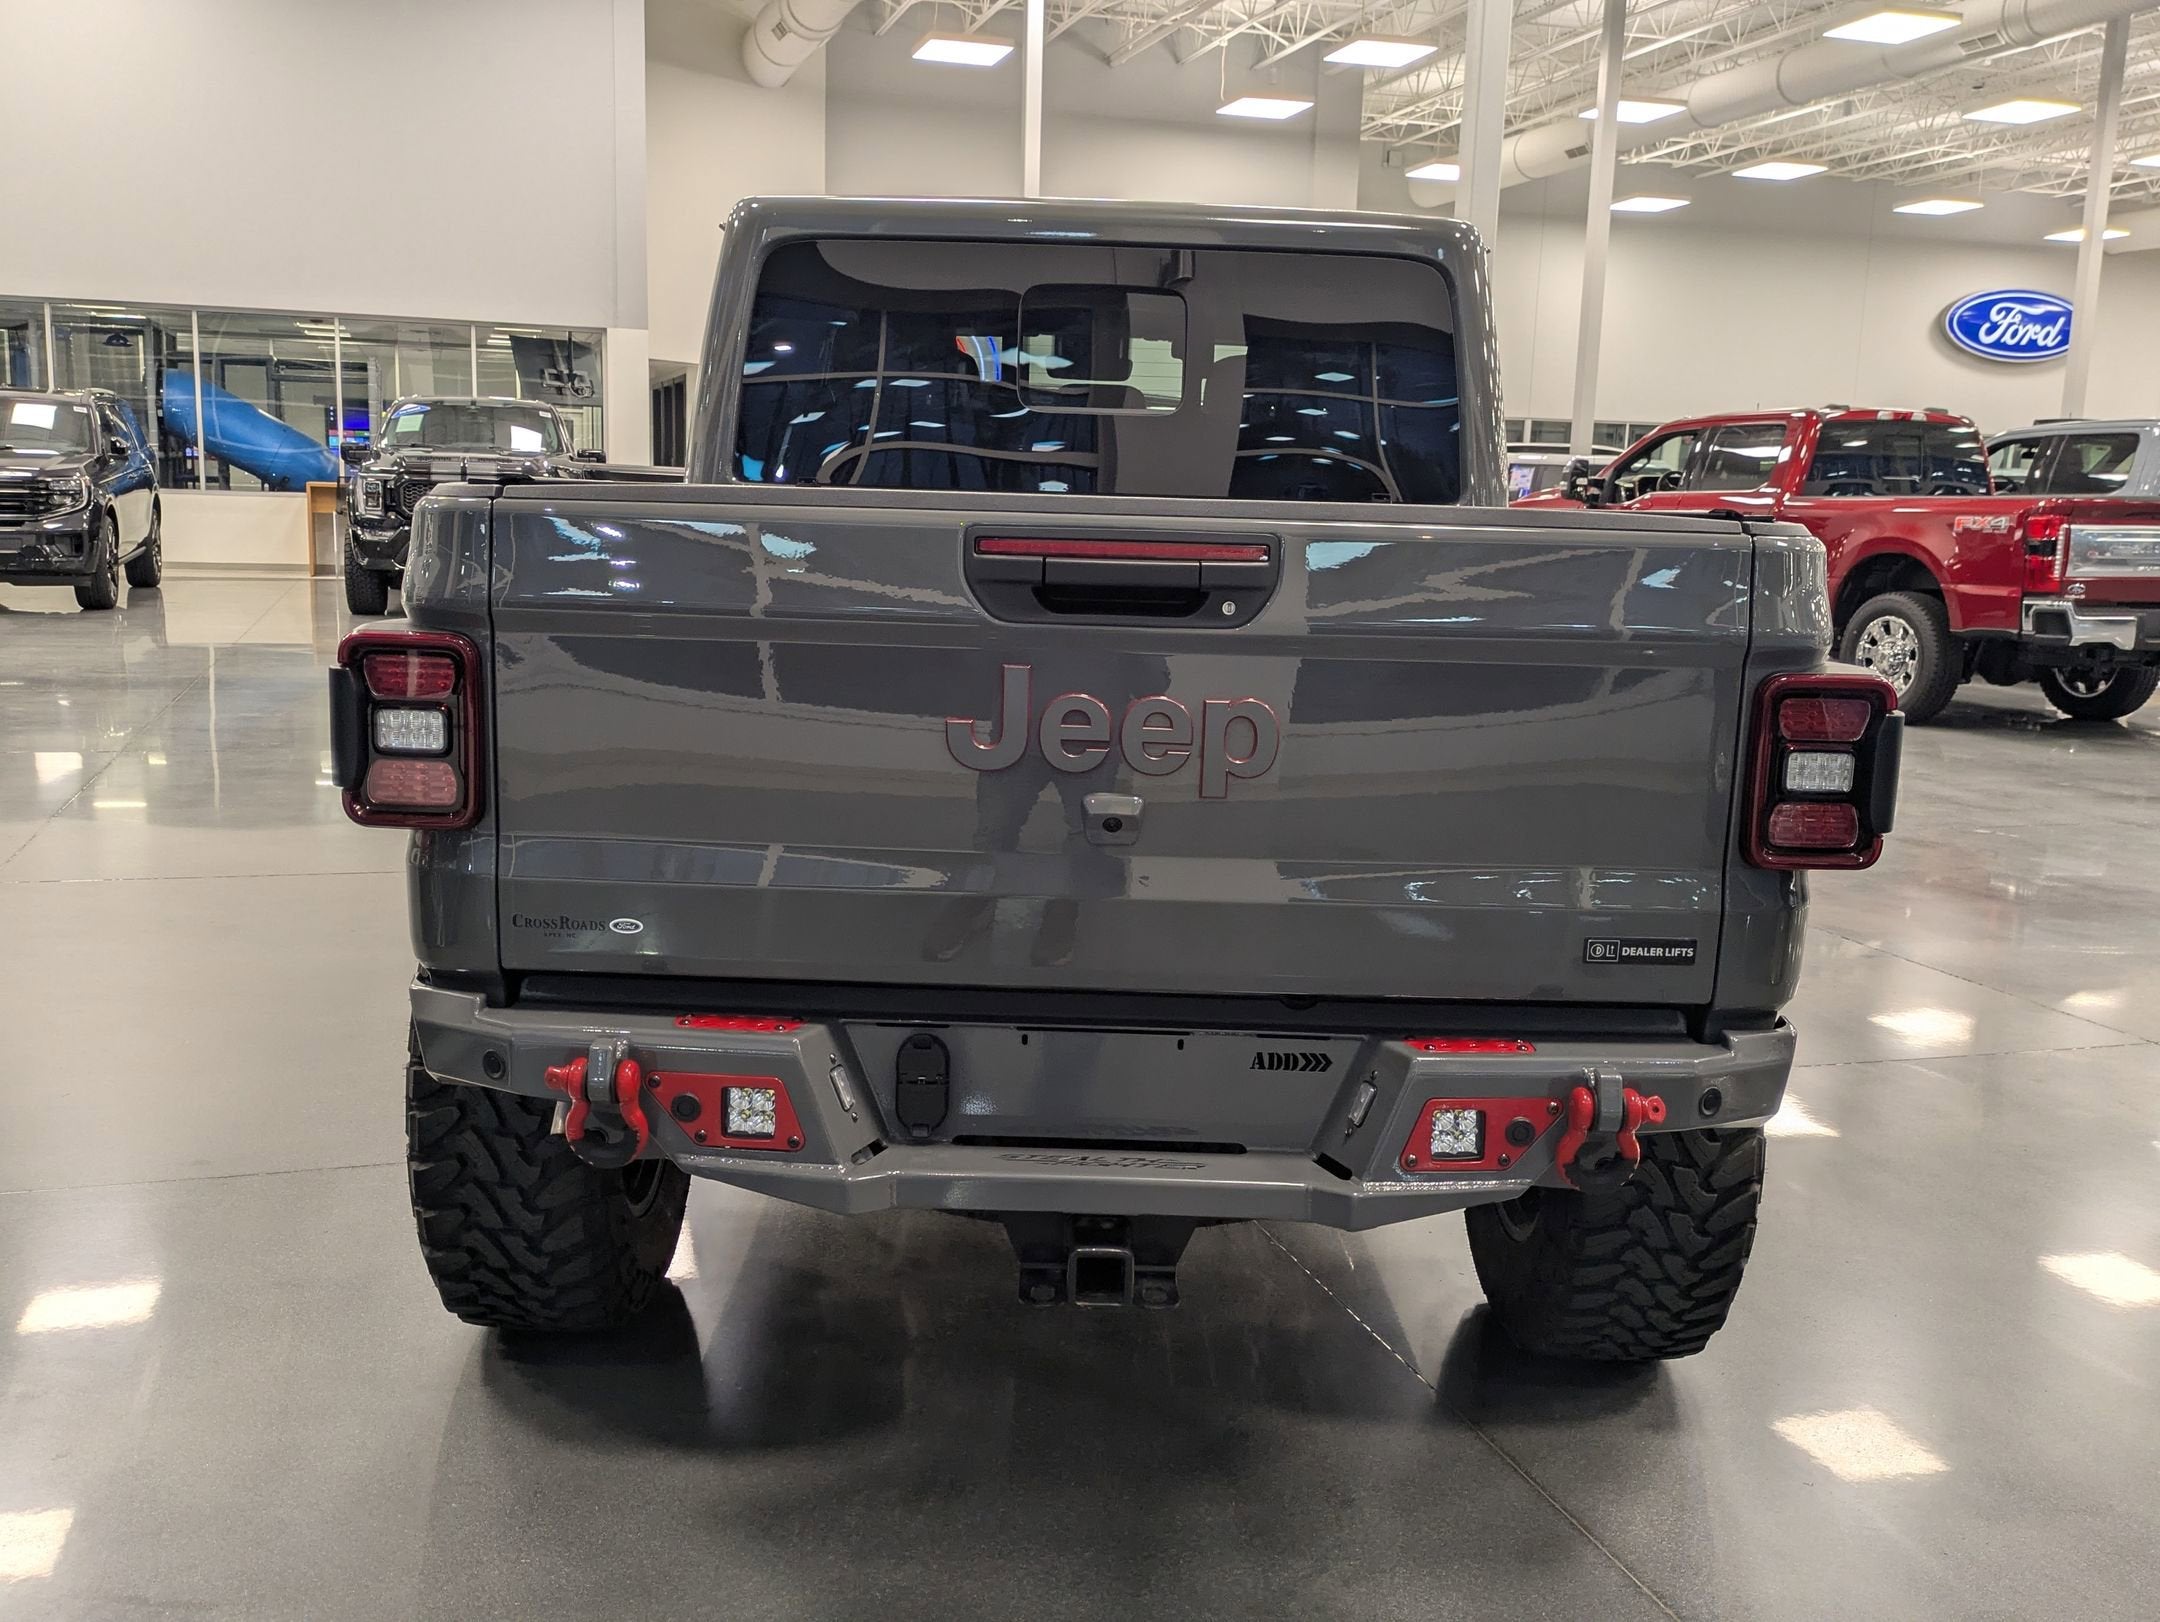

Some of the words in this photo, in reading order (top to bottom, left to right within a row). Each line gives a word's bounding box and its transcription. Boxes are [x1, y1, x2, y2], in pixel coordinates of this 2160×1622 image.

[1978, 302, 2066, 347] Ford
[1953, 515, 2010, 534] FX4
[945, 664, 1279, 799] Jeep
[1621, 946, 1664, 957] DEALER
[1665, 947, 1694, 957] LIFTS
[1249, 1051, 1300, 1072] ADD
